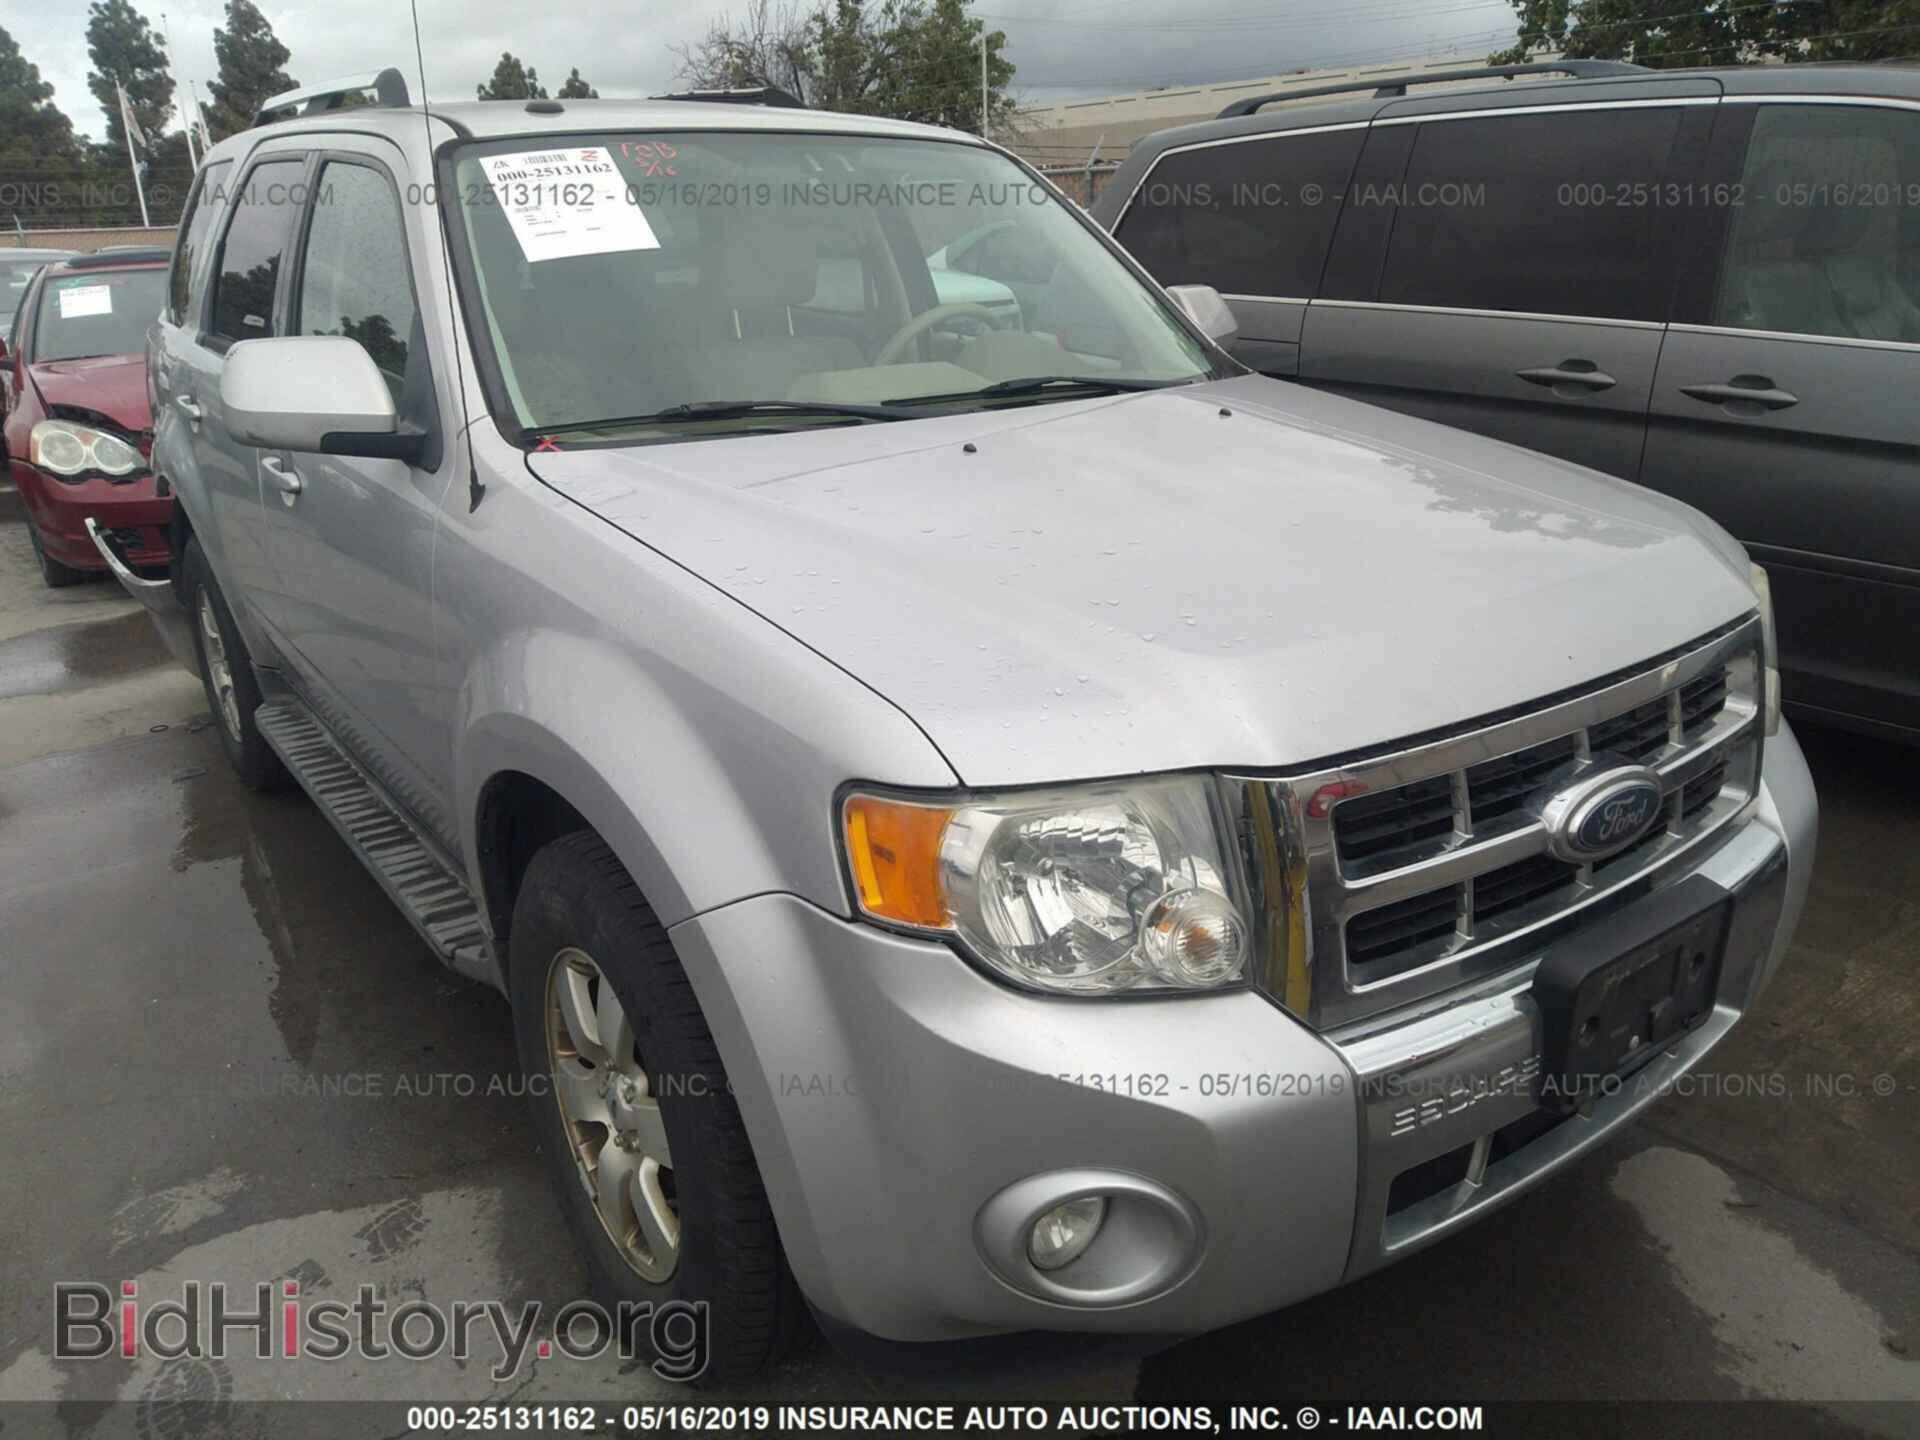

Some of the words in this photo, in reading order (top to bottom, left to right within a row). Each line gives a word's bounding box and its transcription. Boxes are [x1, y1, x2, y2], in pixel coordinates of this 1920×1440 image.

[496, 162, 613, 183] 000-25131162
[1599, 795, 1650, 838] Ford
[1391, 1054, 1541, 1137] ESCAPE
